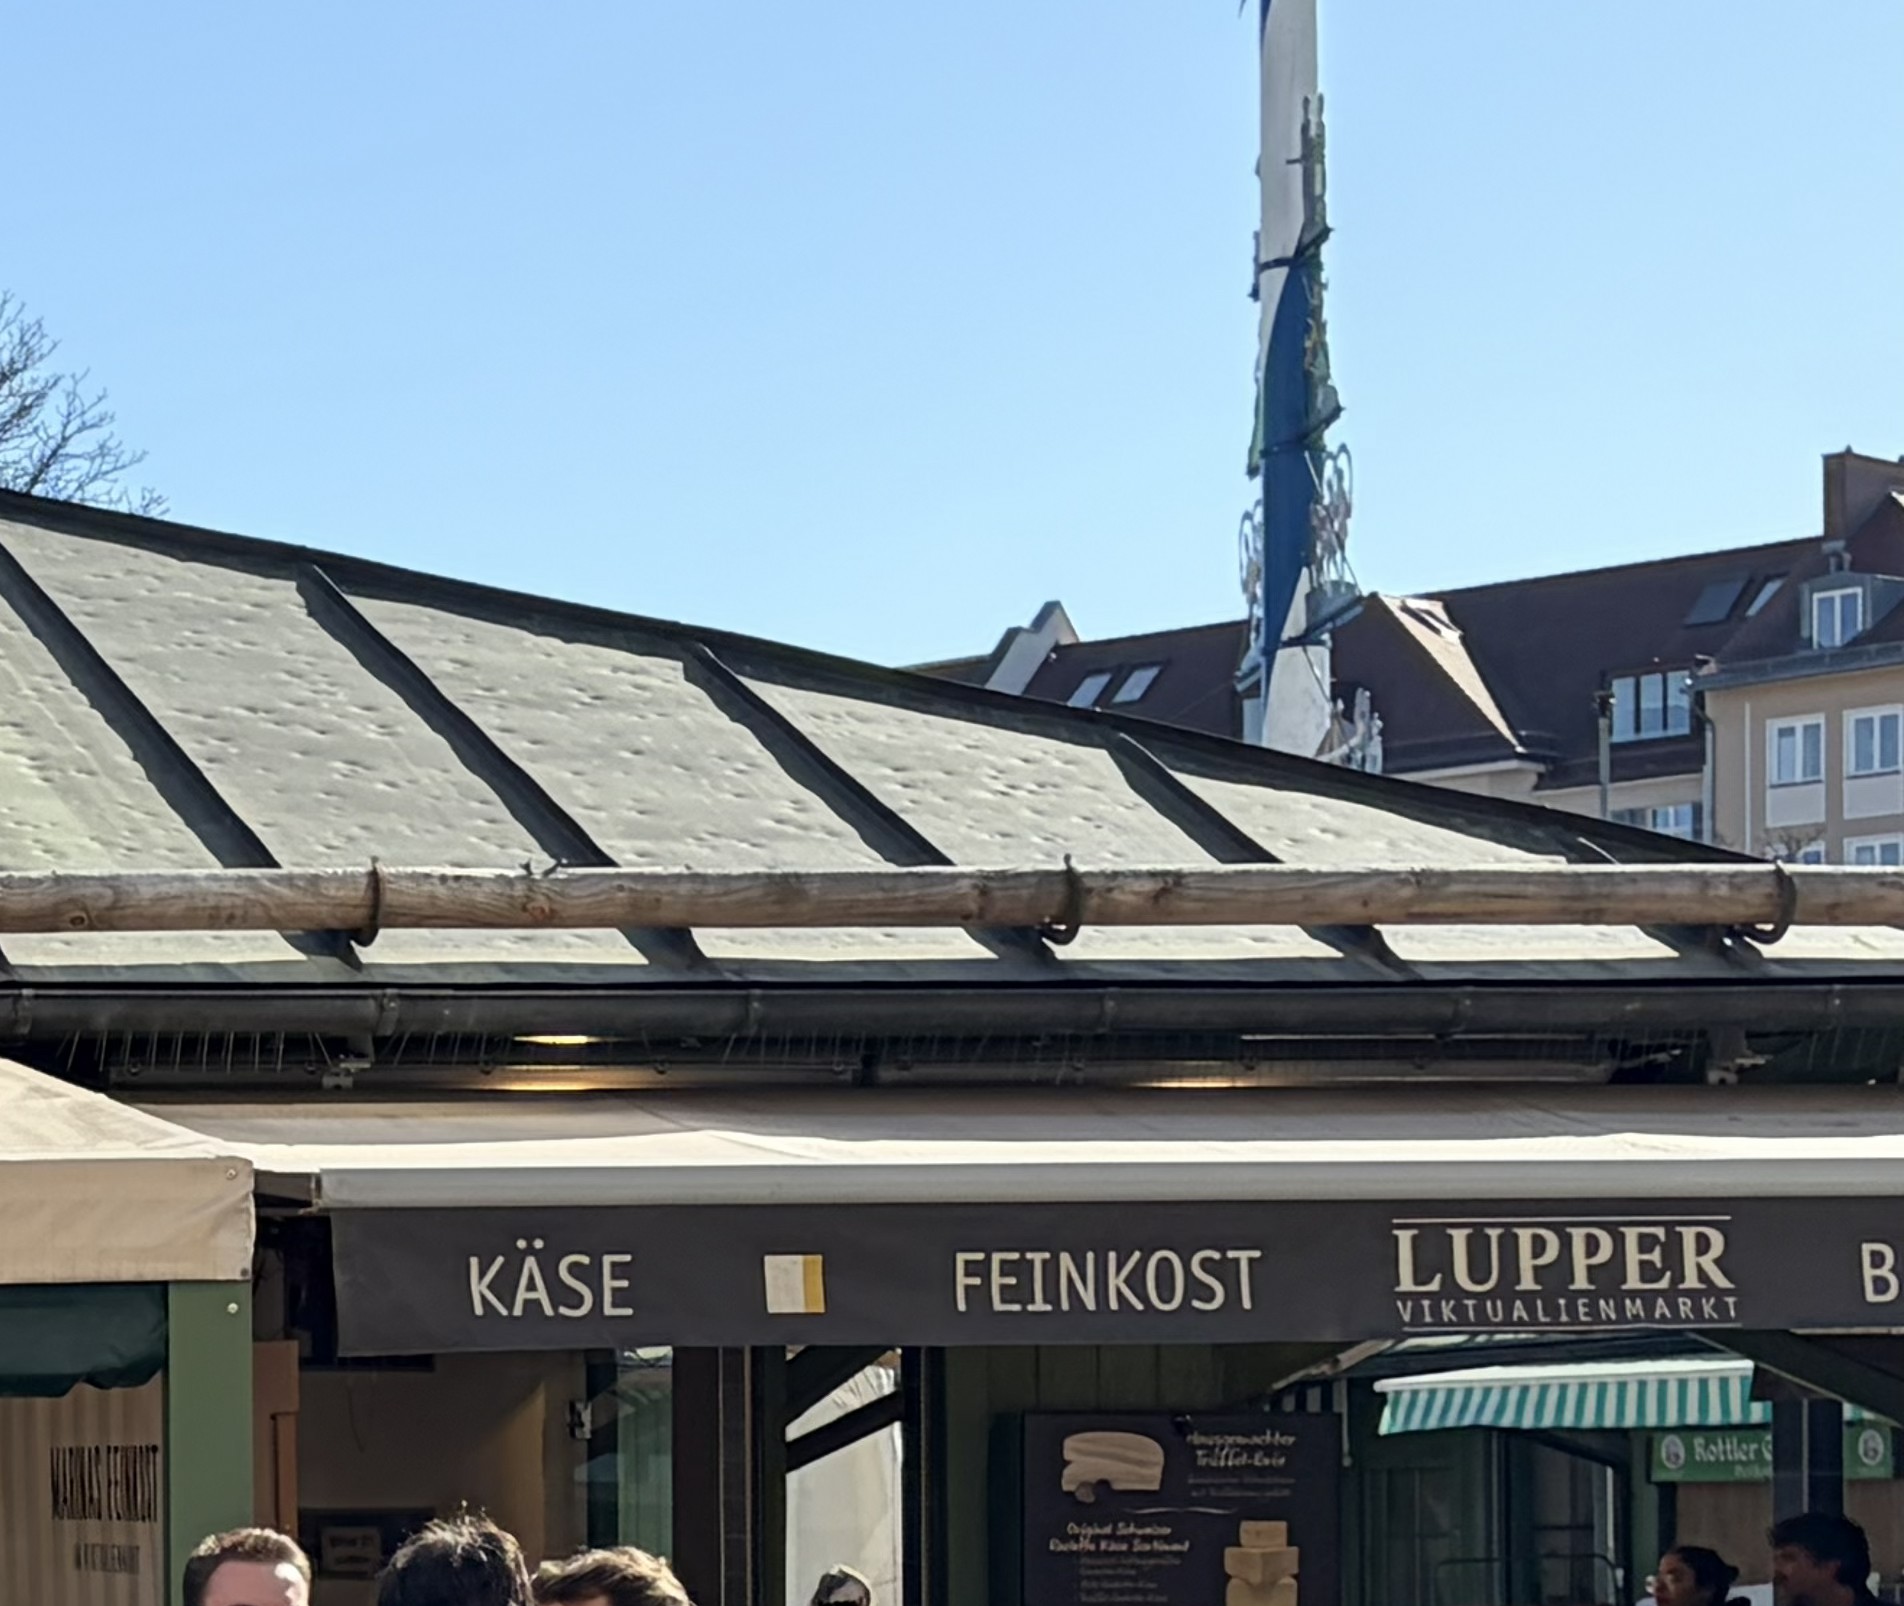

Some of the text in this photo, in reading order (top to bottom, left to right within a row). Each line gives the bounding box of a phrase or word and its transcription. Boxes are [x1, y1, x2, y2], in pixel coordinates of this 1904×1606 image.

[469, 1238, 634, 1317] KÄSE
[955, 1249, 1262, 1312] FEINKOST
[1391, 1226, 1736, 1291] LUPPER
[1396, 1296, 1738, 1323] VIKTUALIENMARKT
[1693, 1435, 1759, 1462] Rottler
